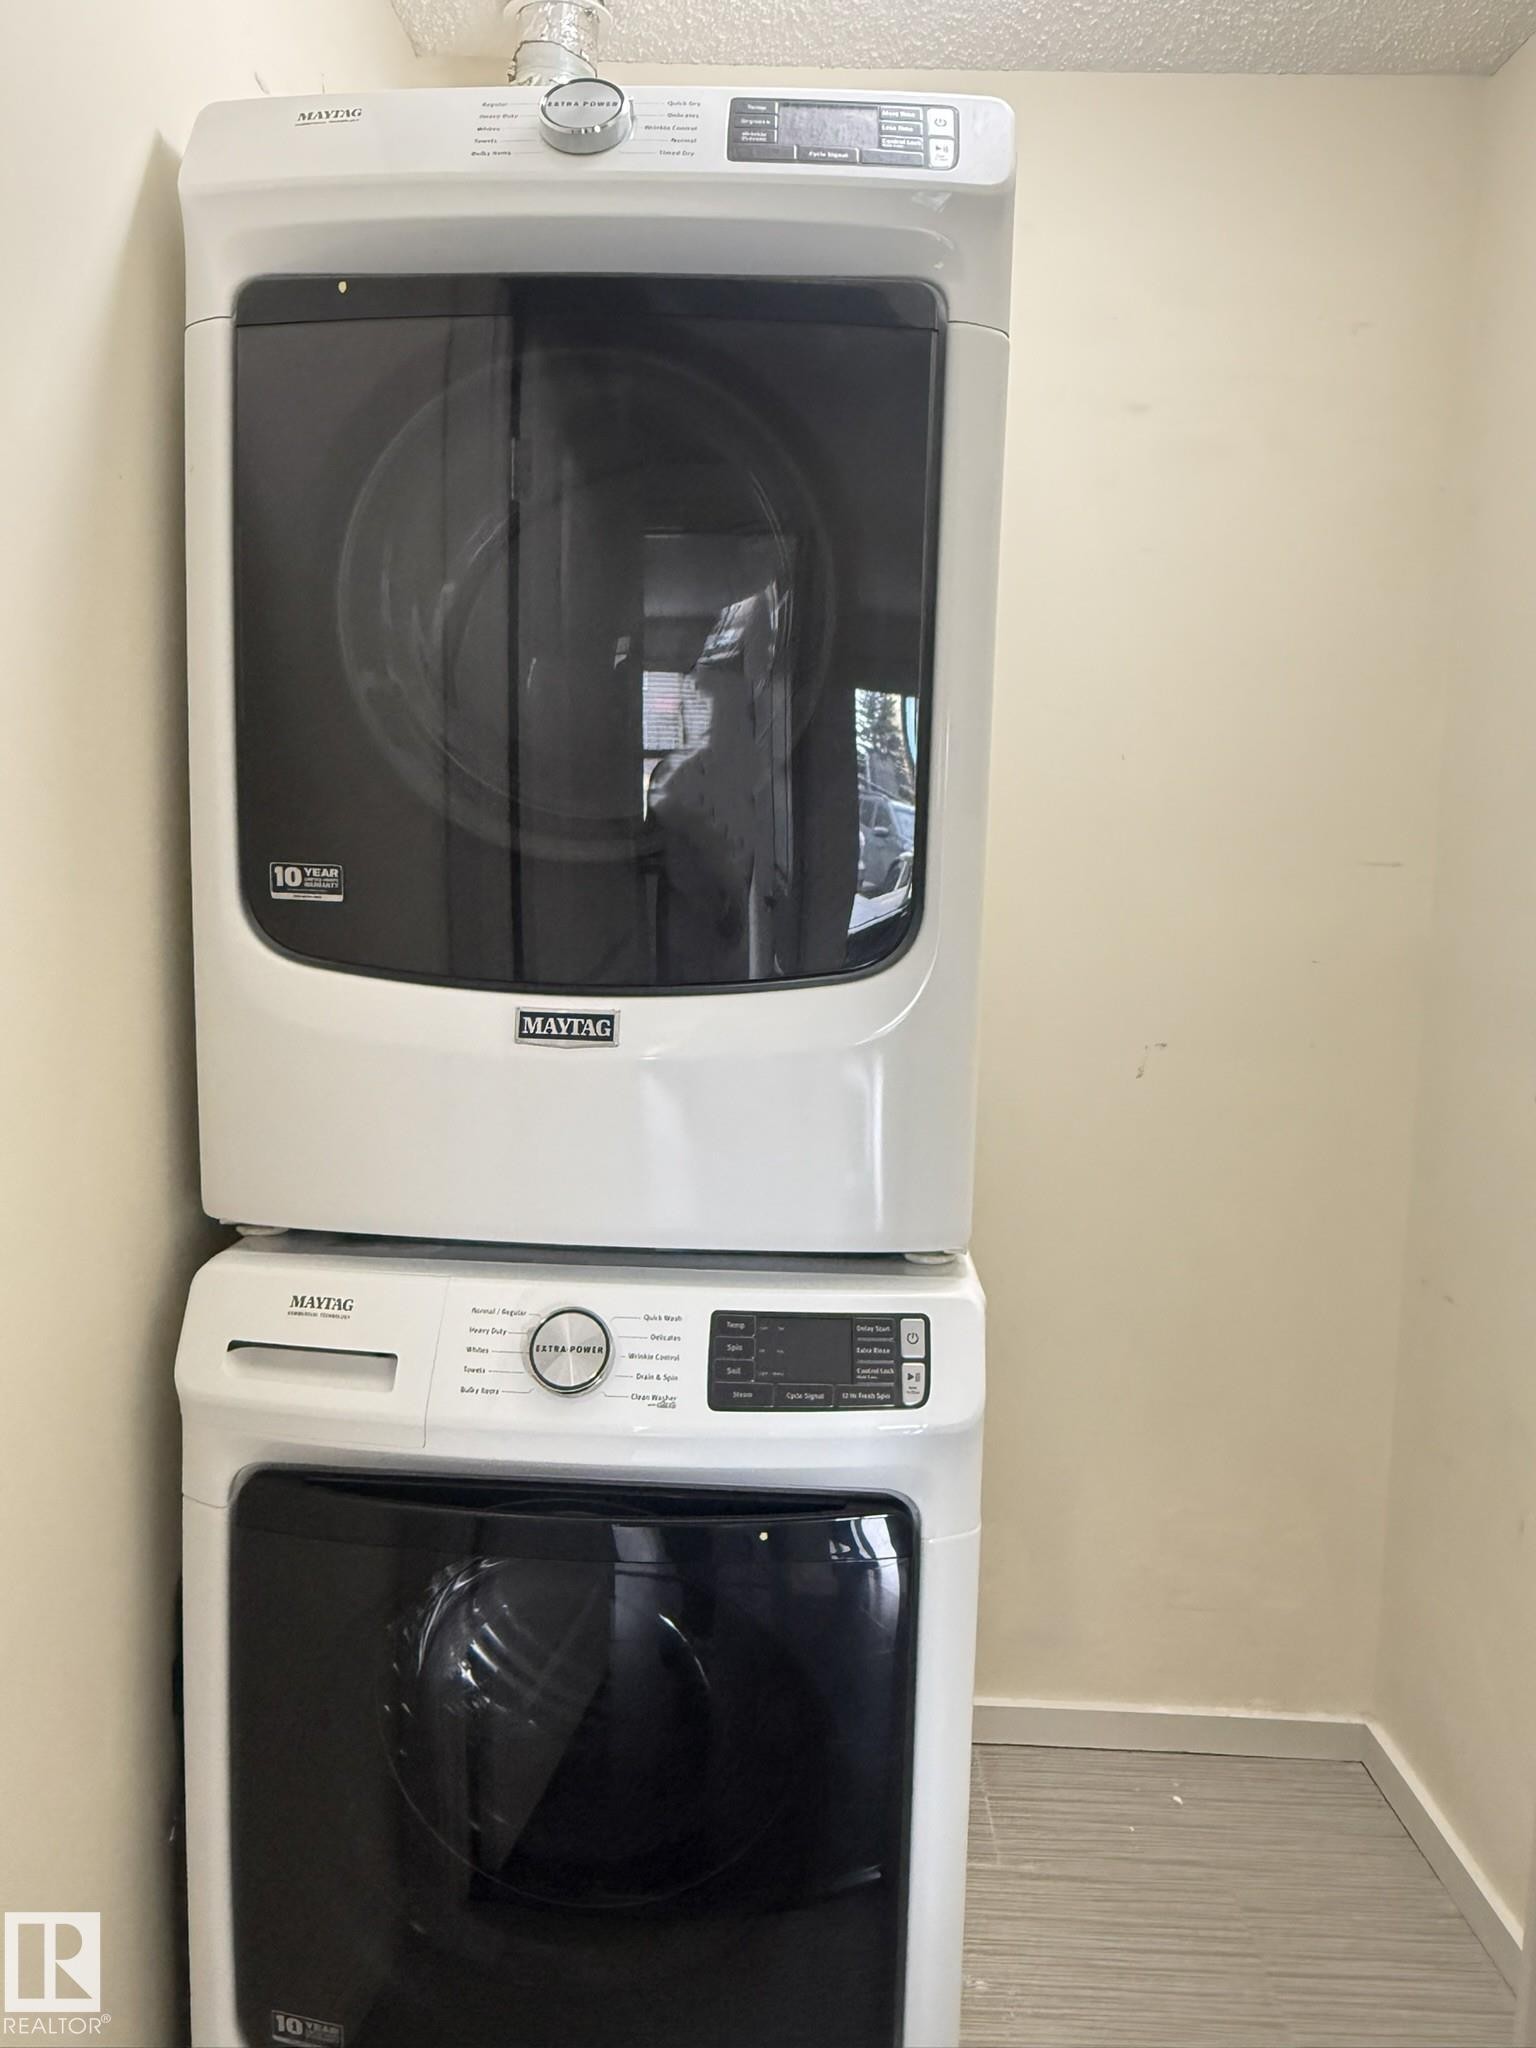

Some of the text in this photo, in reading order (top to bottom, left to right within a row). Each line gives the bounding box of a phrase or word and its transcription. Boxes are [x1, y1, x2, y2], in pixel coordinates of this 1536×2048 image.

[297, 108, 362, 122] MAYTAG
[274, 865, 339, 887] 10 YEAR
[521, 1016, 612, 1037] MAYTAG
[289, 1295, 354, 1312] MAYTAG
[471, 1307, 496, 1315] Normal
[501, 1308, 527, 1317] Regular
[726, 1321, 746, 1330] Temp
[469, 1326, 508, 1336] Heavy Duty
[726, 1344, 743, 1352] Spin
[655, 1353, 680, 1361] Control
[726, 1367, 741, 1375] Soil
[663, 1374, 679, 1382] Spin
[631, 1393, 650, 1401] Clean
[786, 1392, 824, 1401] Cycle Signal
